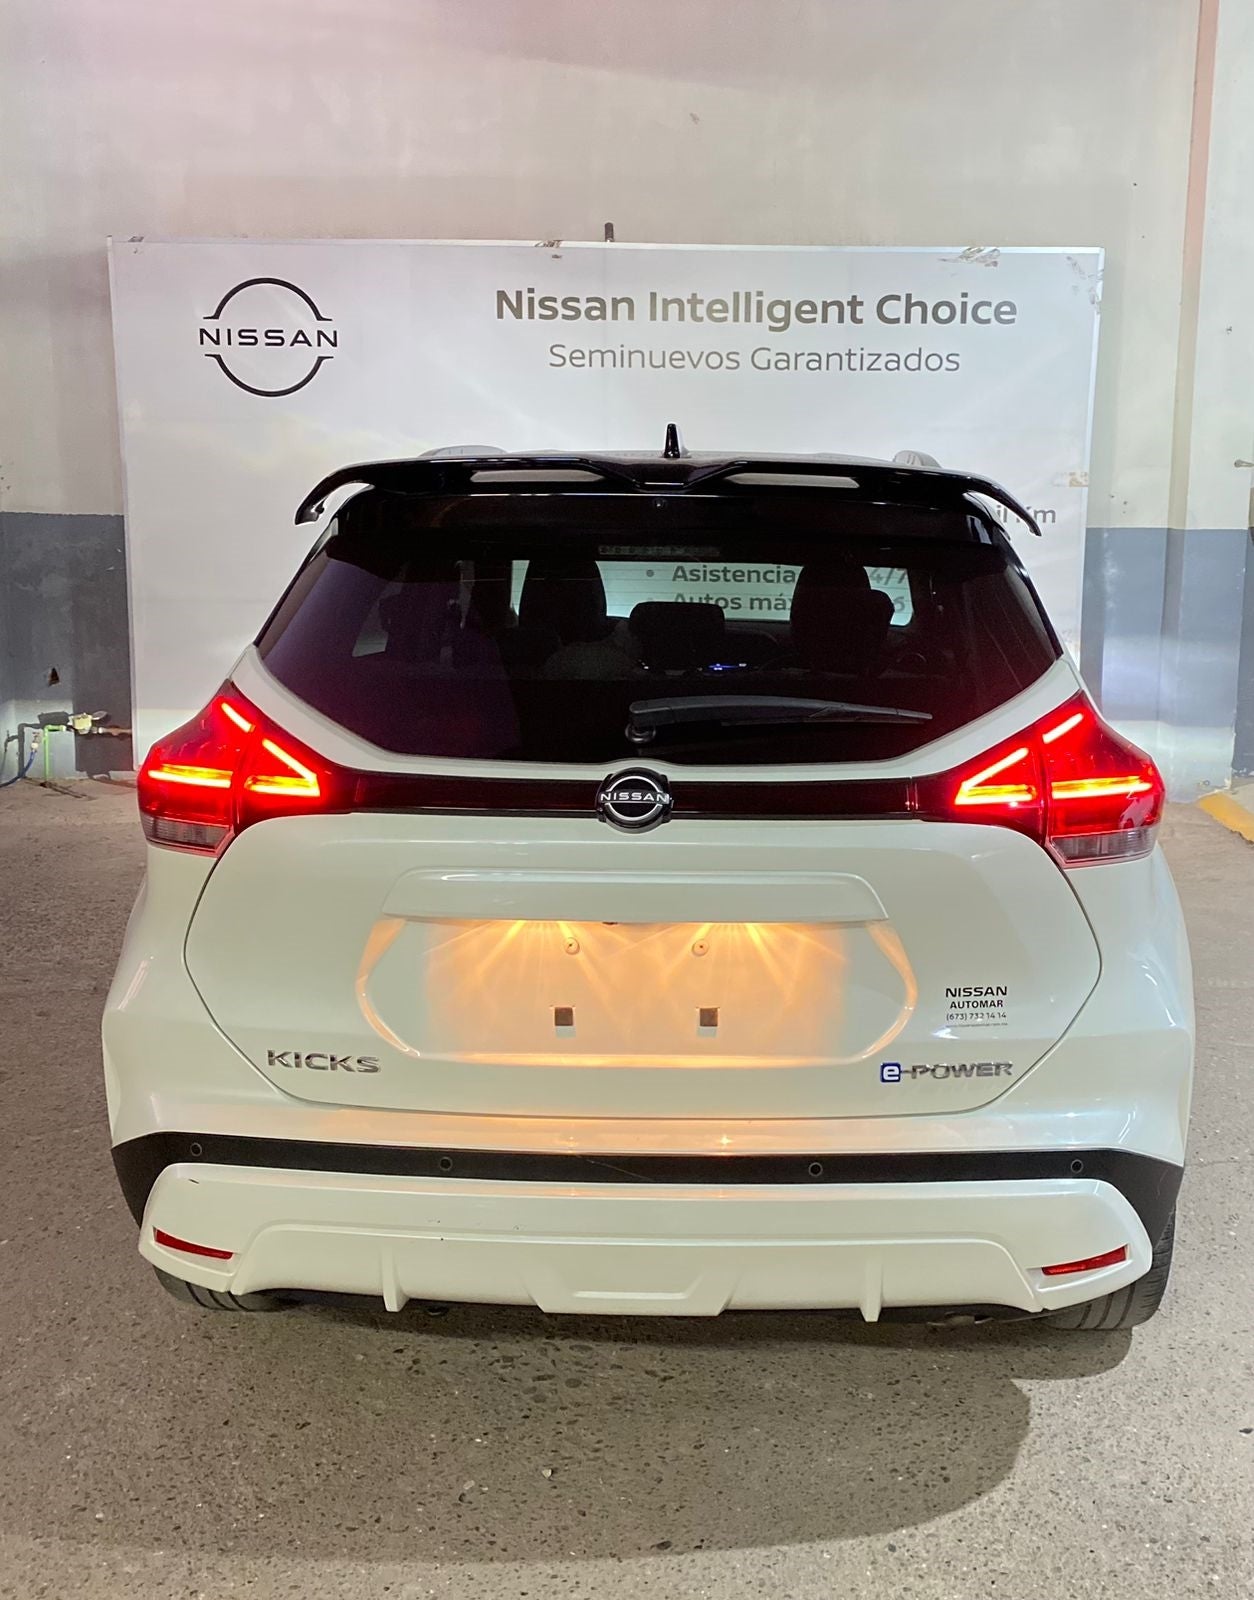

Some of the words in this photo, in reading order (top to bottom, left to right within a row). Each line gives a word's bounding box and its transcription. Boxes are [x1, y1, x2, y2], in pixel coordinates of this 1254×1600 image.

[496, 288, 635, 322] Nissan
[649, 290, 864, 332] Intelligent
[876, 291, 1018, 325] Choice
[200, 328, 338, 348] NISSAN
[548, 344, 740, 370] Seminuevos
[751, 346, 961, 373] Garantizados
[672, 564, 798, 583] Asistencia
[600, 792, 668, 803] NISSAN
[946, 986, 1008, 998] NISSAN
[950, 1000, 1004, 1009] AUTOMAR
[946, 1012, 967, 1022] (673)
[986, 1011, 996, 1020] 14
[997, 1011, 1007, 1019] 14
[267, 1049, 380, 1073] KICKS
[881, 1062, 1013, 1082] e-POWER
